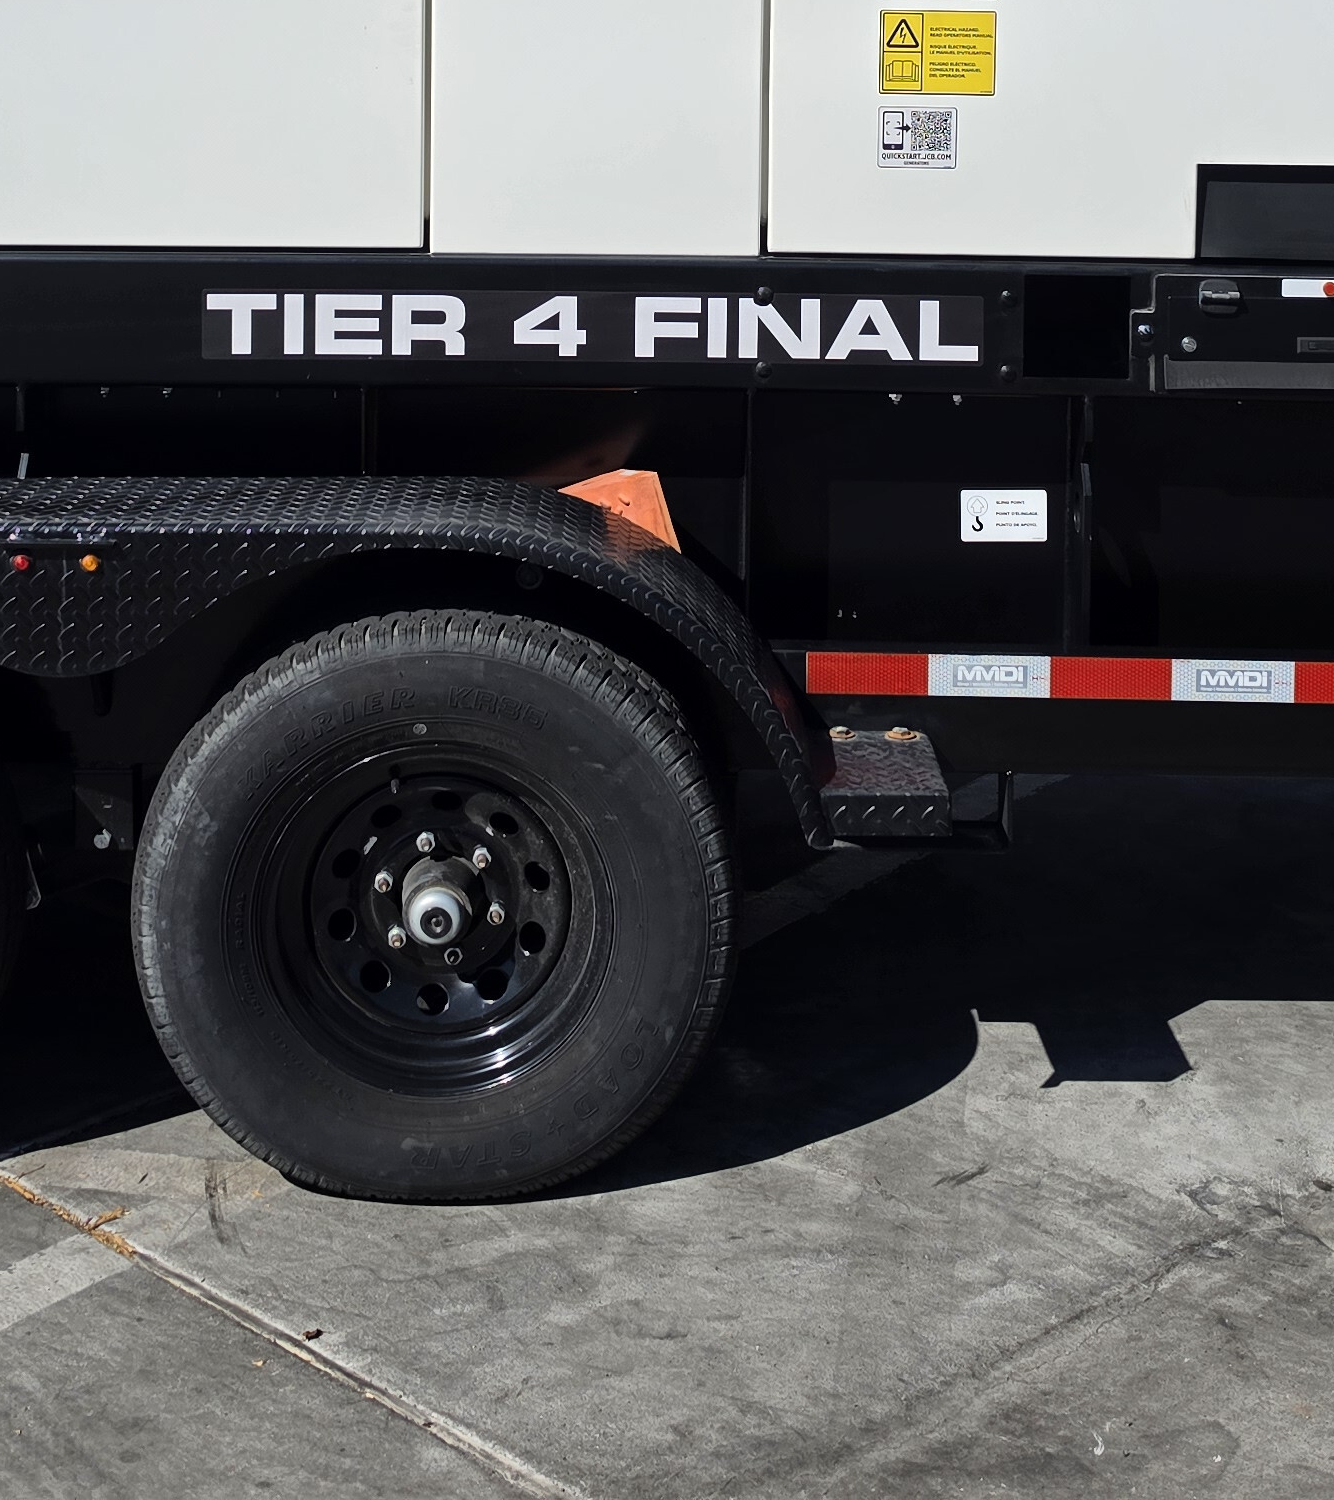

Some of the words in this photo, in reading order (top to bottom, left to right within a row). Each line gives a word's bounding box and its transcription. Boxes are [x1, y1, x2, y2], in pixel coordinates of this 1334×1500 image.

[882, 152, 952, 161] QUICKSTART.JCB.COM
[206, 293, 467, 356] TIER
[513, 295, 587, 357] 4
[633, 296, 979, 362] FINAL
[236, 686, 417, 802] KARRIER
